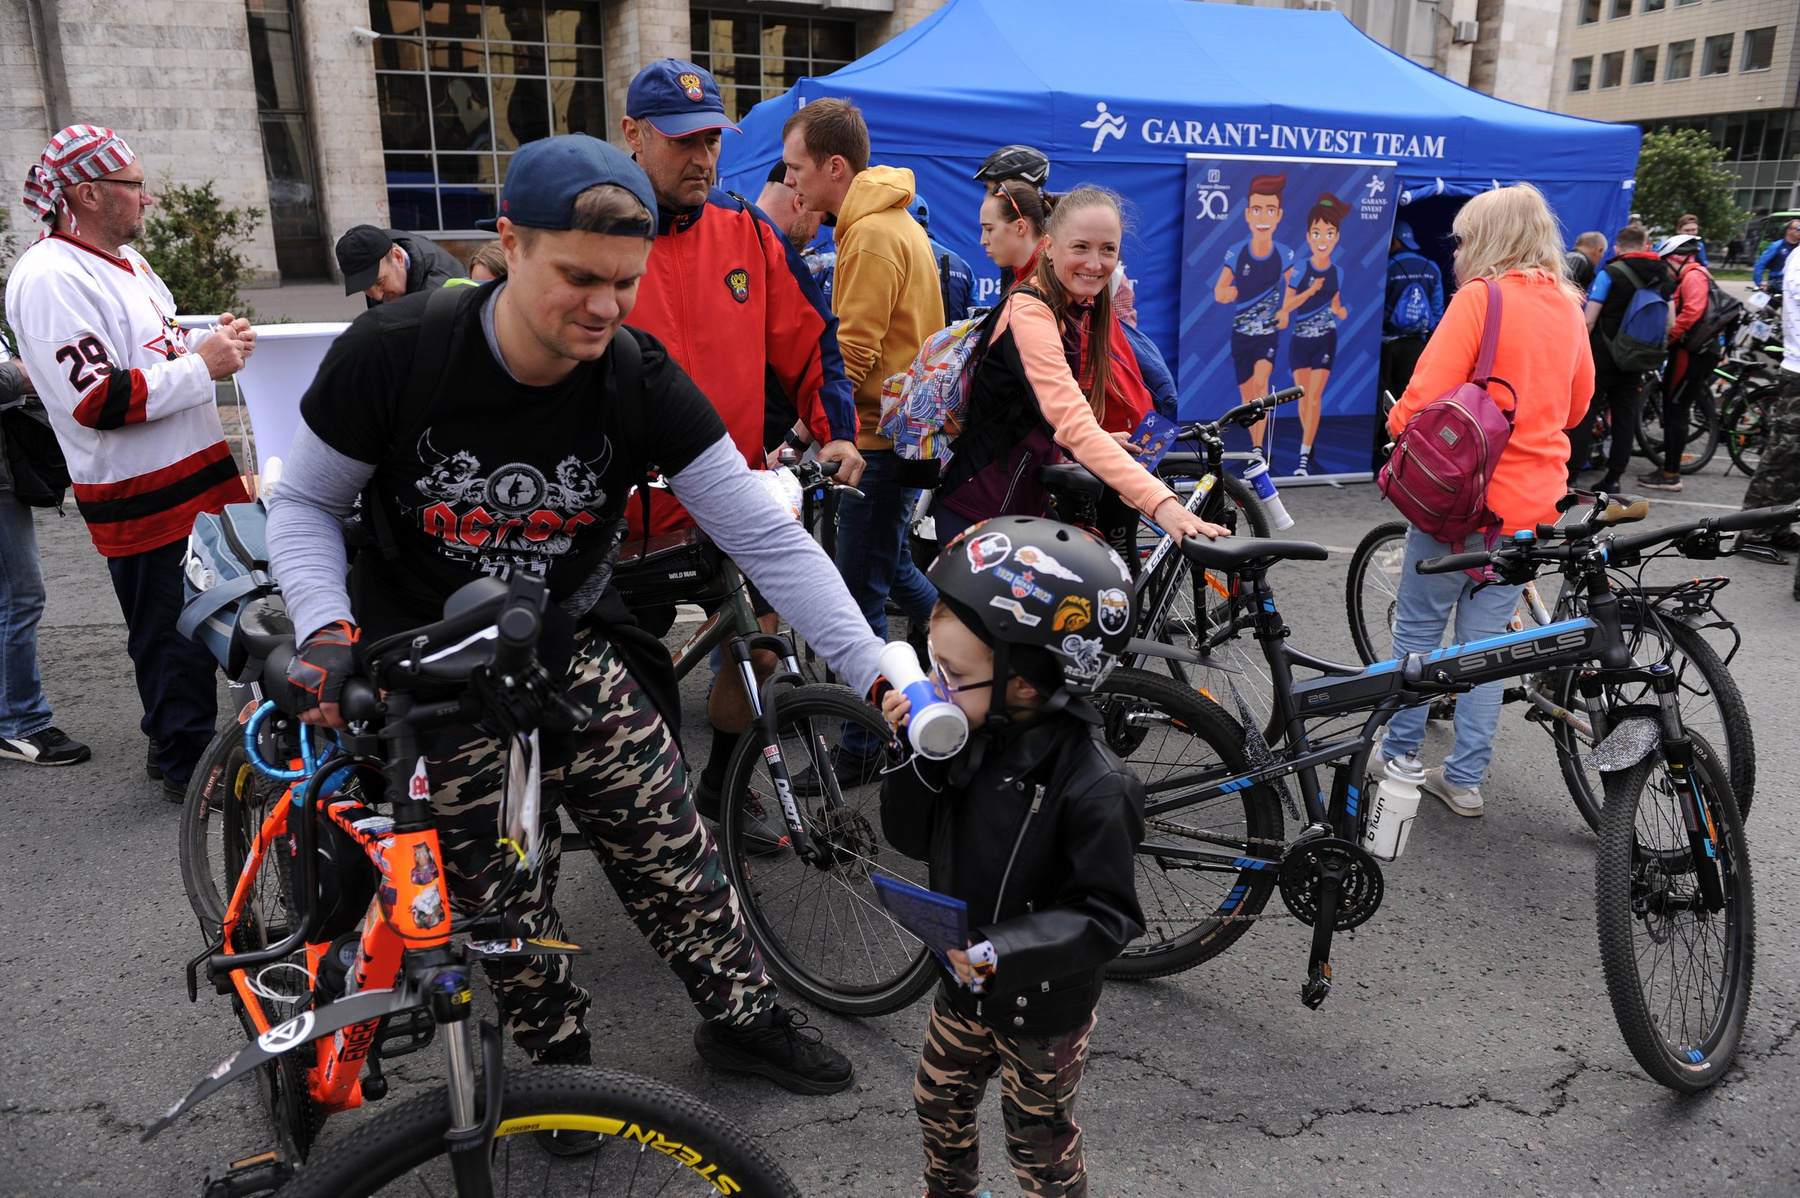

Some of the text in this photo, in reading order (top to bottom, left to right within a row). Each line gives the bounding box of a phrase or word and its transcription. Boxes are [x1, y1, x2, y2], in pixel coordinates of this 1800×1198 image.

[1141, 117, 1446, 159] GARANT-INVEST TEAM
[1196, 190, 1229, 220] 30
[55, 336, 118, 393] 29
[1458, 630, 1587, 672] STELS
[1308, 692, 1330, 703] 26
[774, 778, 802, 829] DART
[503, 1123, 540, 1134] ENERGY
[623, 1123, 741, 1196] STERN
